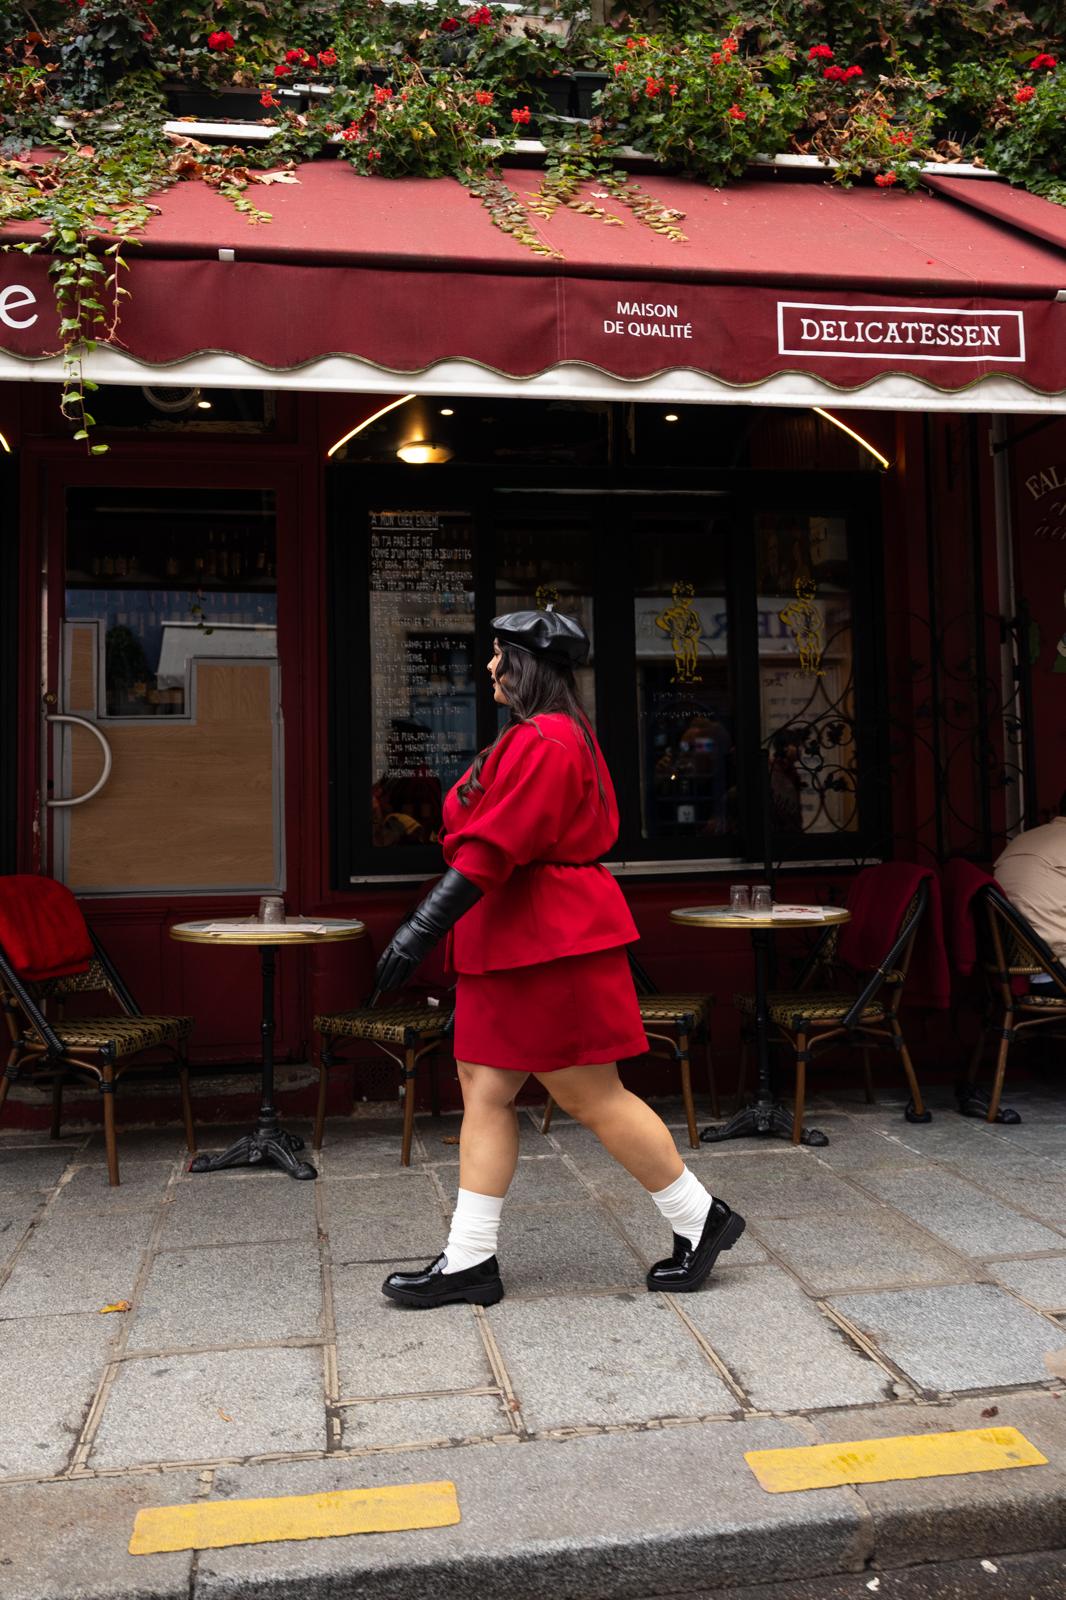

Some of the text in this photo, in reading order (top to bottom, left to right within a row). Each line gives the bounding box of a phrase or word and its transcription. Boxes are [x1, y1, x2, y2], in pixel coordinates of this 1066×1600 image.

[0, 285, 38, 329] e
[617, 302, 677, 317] MAISON
[604, 321, 692, 338] DE QUALITÉ
[801, 319, 1000, 347] DELICATESSEN
